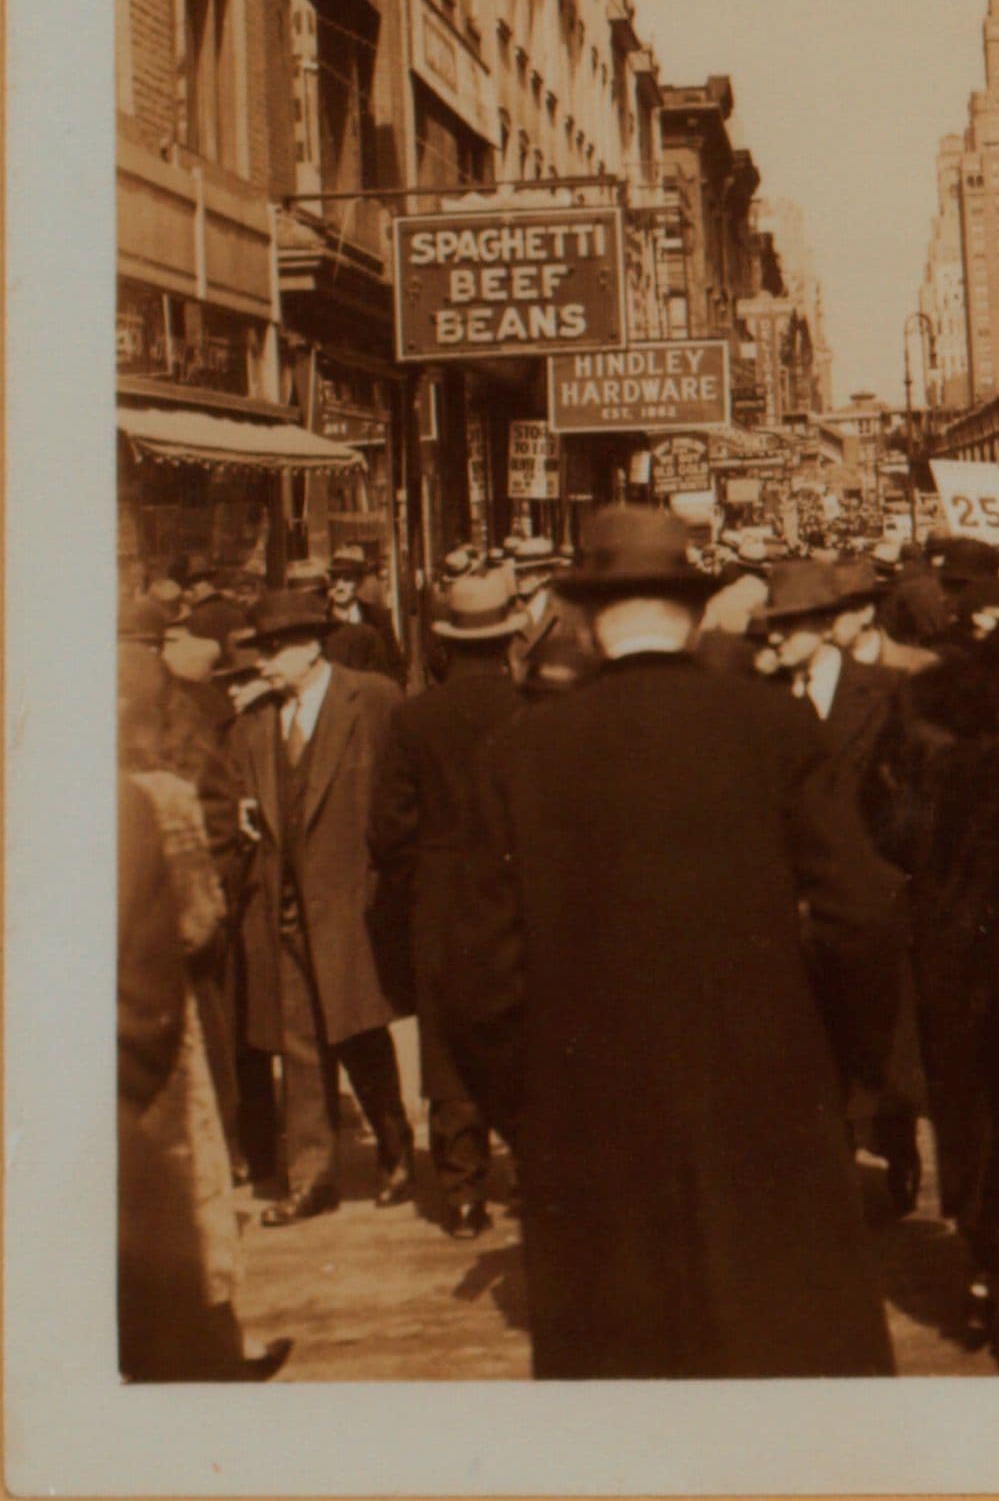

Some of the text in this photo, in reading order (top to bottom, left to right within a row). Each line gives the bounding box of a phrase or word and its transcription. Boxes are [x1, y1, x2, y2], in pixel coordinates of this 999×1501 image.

[410, 224, 605, 265] SPAGHETTI
[450, 264, 569, 303] BEEF
[435, 304, 586, 343] BEANS
[574, 349, 704, 378] HINDLEY
[560, 376, 718, 406] HARDWARE
